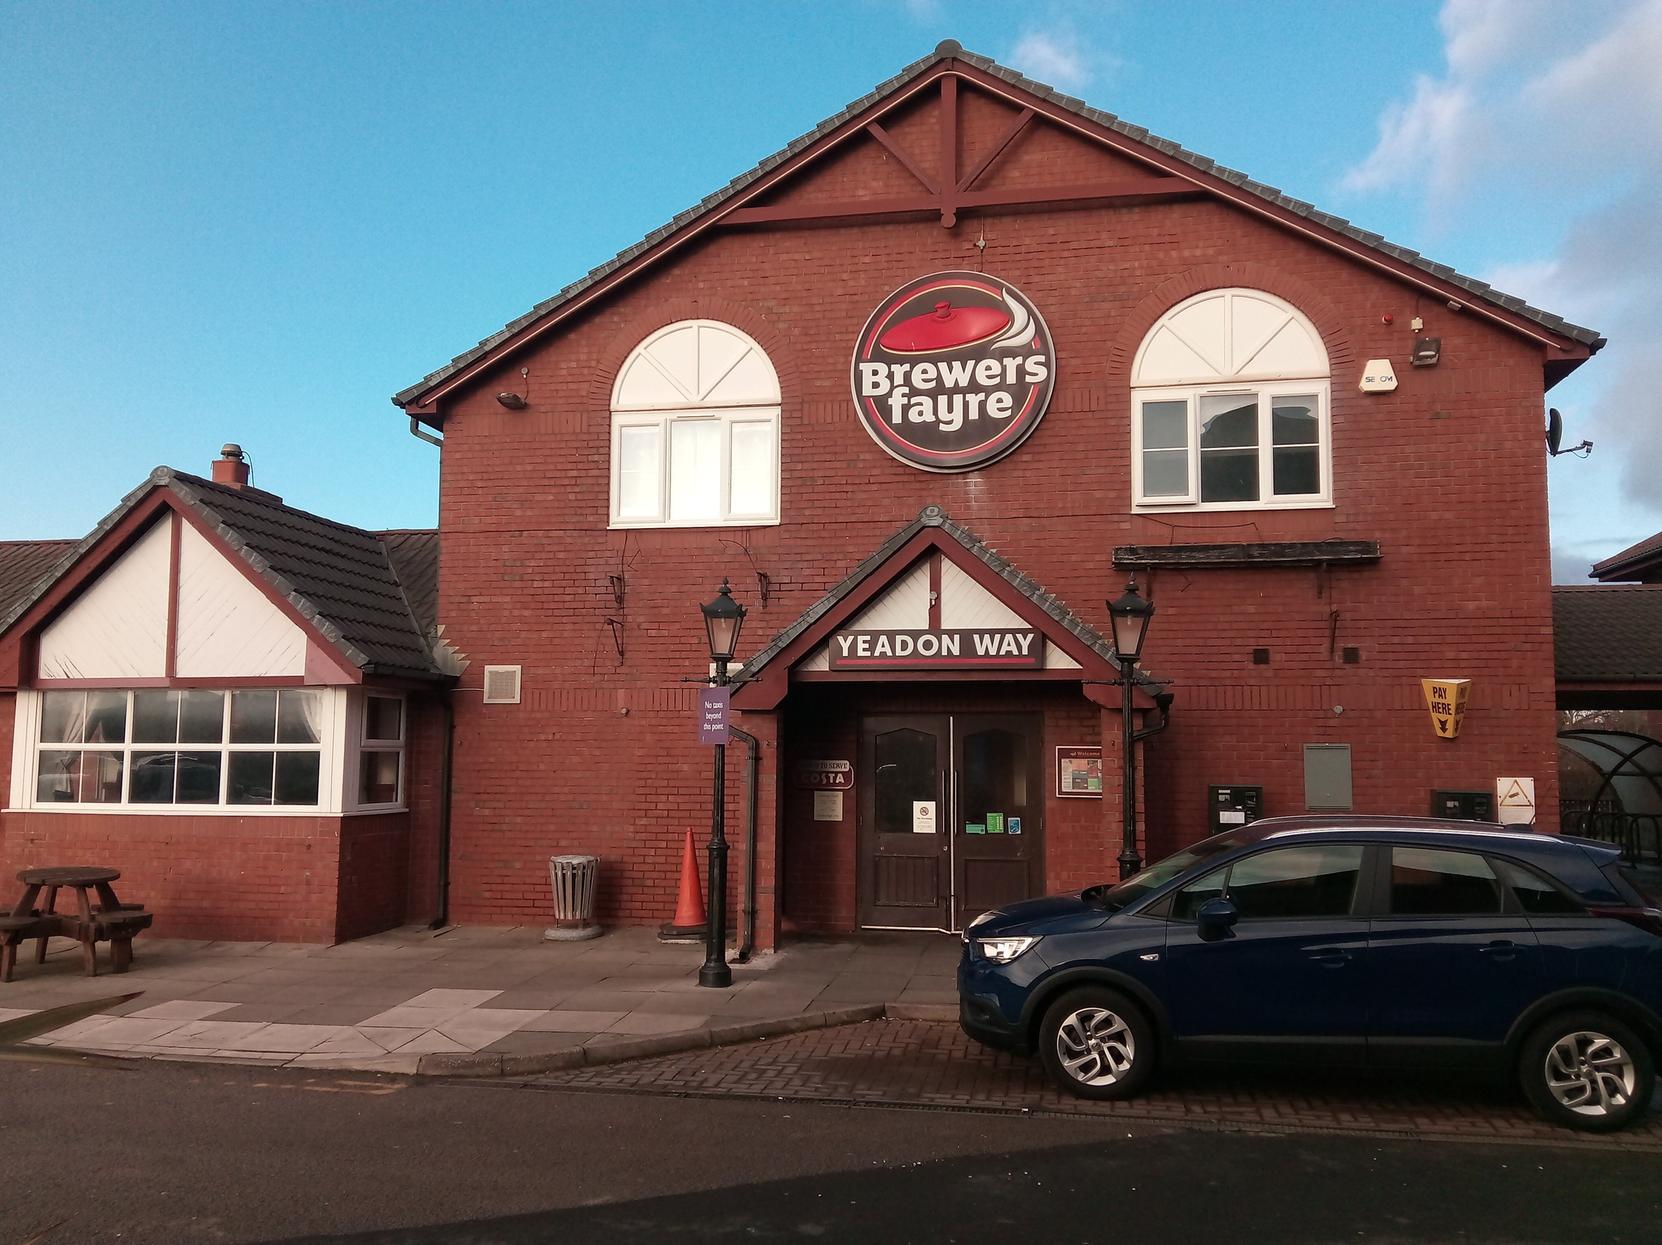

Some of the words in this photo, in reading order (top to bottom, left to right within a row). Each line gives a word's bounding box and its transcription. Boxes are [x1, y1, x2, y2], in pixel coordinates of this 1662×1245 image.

[859, 354, 1048, 396] Brewers
[1365, 375, 1393, 383] SEOM
[888, 386, 1013, 432] fayre
[836, 634, 960, 657] YEADON
[973, 633, 1034, 656] WAY
[1432, 686, 1447, 700] PAY
[704, 701, 712, 709] No
[1431, 701, 1452, 715] HERE
[705, 711, 722, 721] beyond
[711, 722, 724, 732] point
